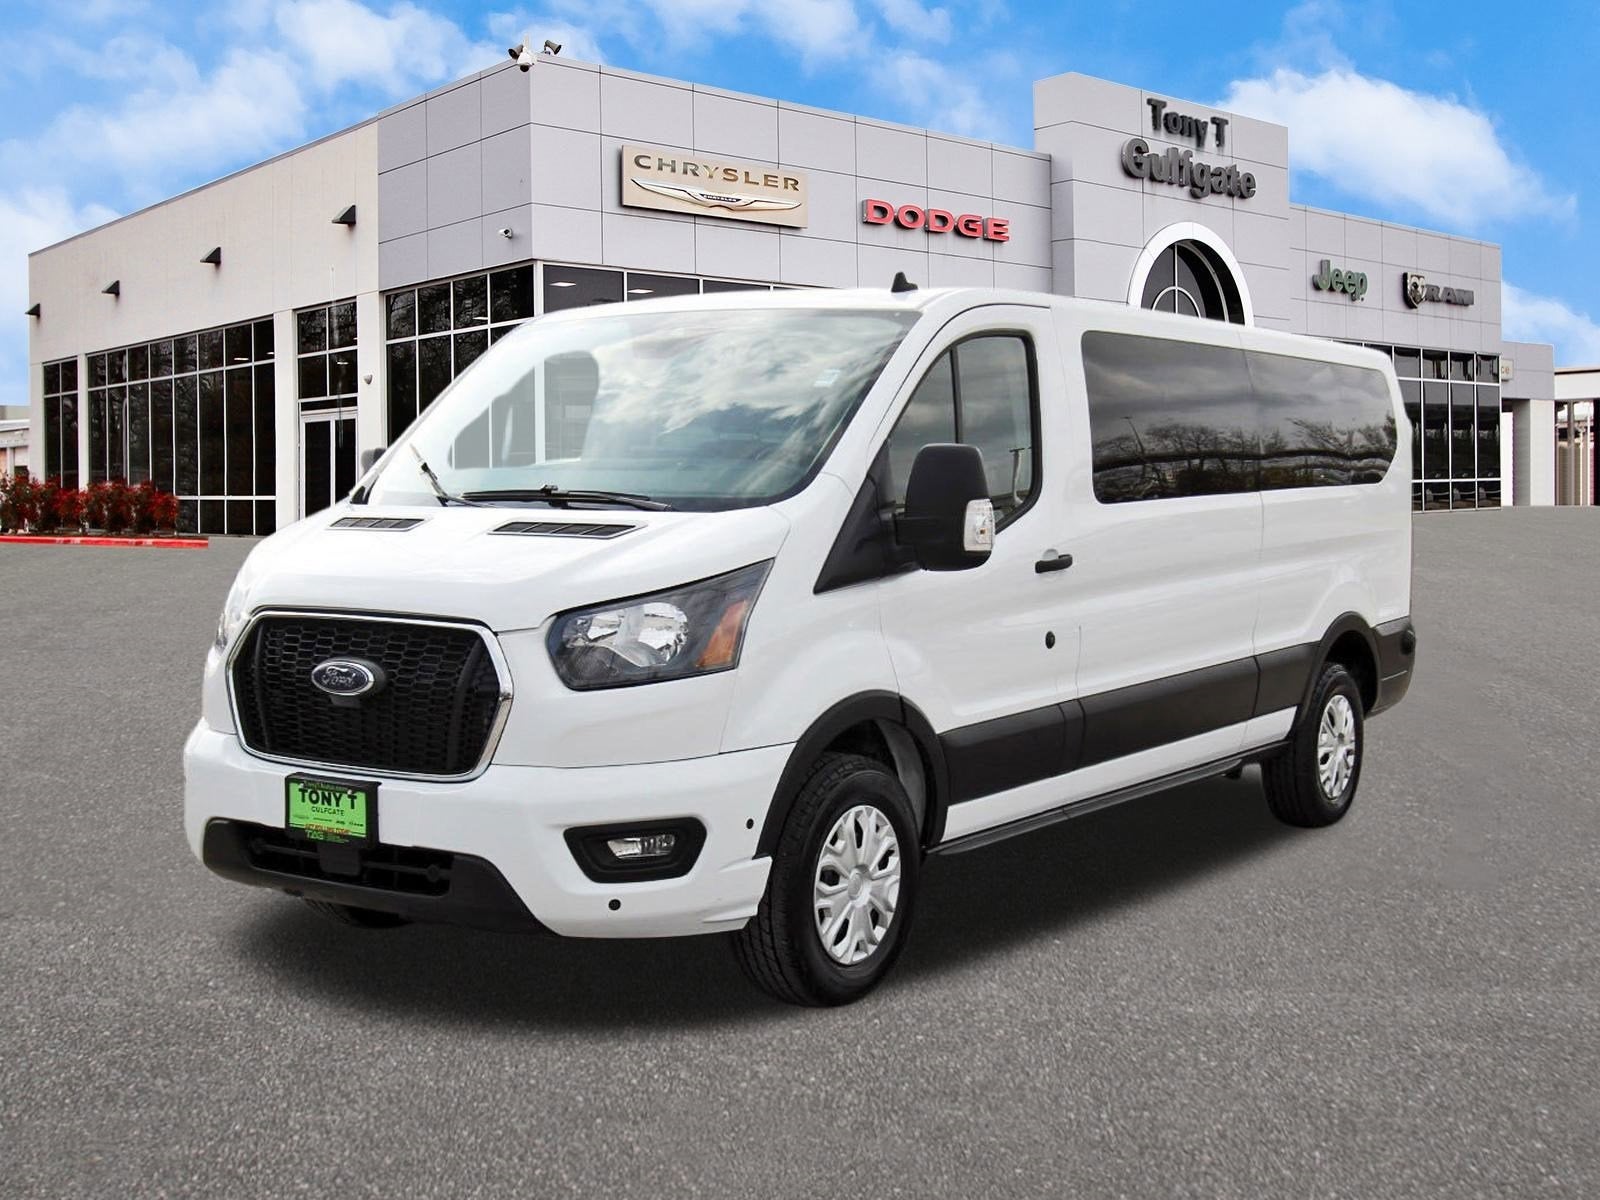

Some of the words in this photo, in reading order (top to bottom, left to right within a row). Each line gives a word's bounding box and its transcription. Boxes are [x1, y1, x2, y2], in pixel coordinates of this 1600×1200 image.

[1147, 98, 1208, 148] Tony
[1210, 116, 1229, 147] T
[634, 154, 800, 192] CHRYSLER
[1121, 138, 1256, 199] Gulfgate
[863, 198, 1010, 242] DODGE
[1312, 259, 1368, 301] Jeep
[1425, 284, 1474, 307] RAM
[298, 788, 343, 808] TONY
[347, 794, 357, 810] T
